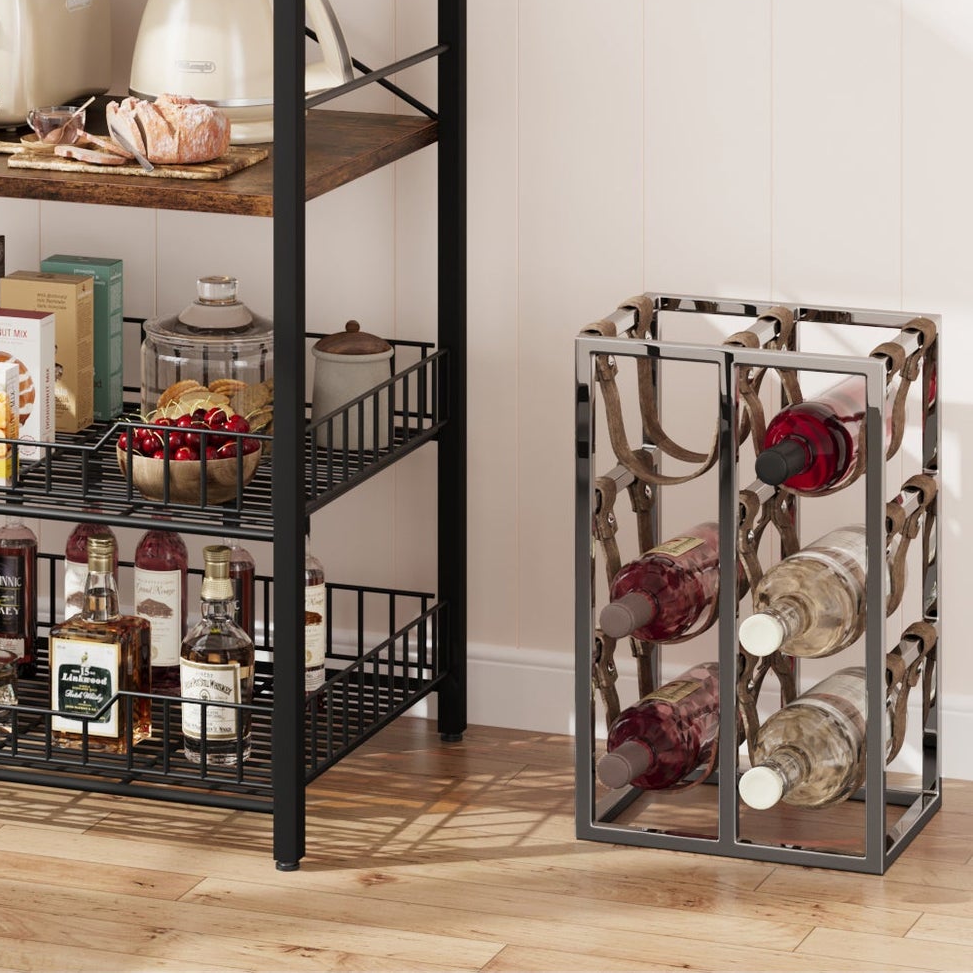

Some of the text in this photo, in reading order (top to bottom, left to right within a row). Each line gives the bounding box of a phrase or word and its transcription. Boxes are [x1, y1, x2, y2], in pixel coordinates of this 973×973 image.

[13, 328, 28, 338] MIX
[80, 667, 90, 676] 15
[61, 673, 107, 685] Linkwood
